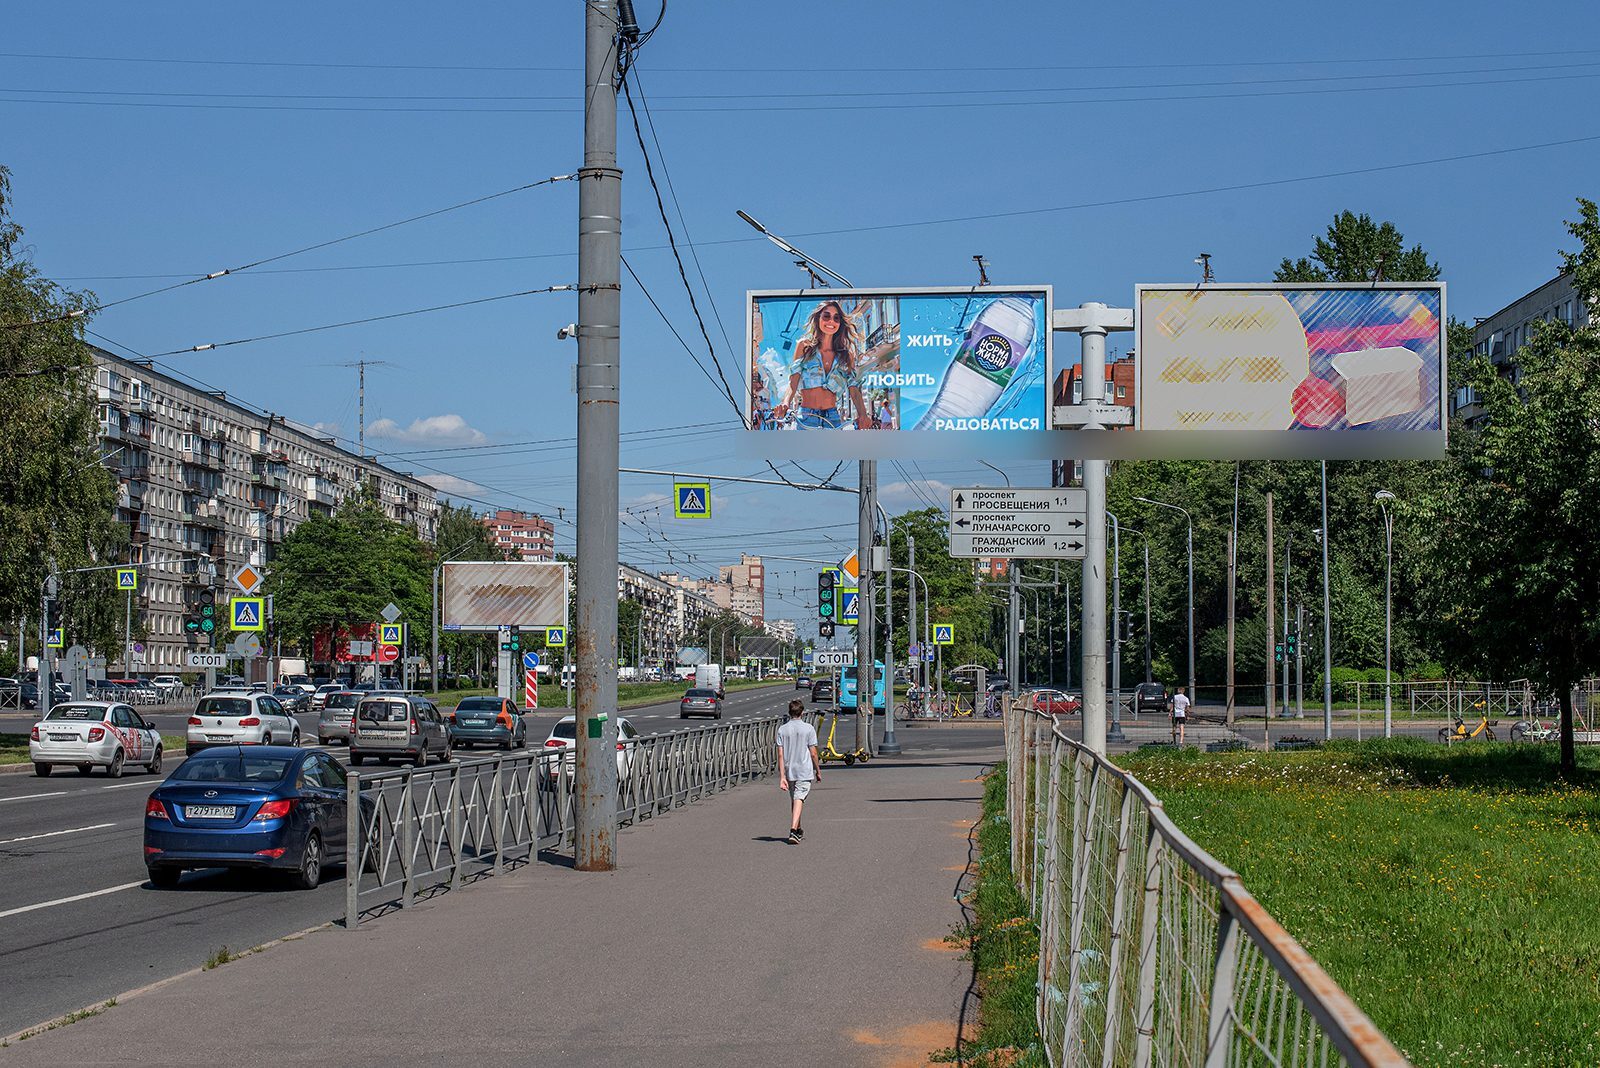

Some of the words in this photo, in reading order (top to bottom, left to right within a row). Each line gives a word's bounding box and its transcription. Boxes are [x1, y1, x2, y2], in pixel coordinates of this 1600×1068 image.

[907, 335, 953, 347] ЖИТЬ
[980, 339, 1009, 361] НОРМА
[976, 347, 1007, 368] ЖИЗНИ
[867, 373, 935, 386] ЛЮБИТЬ
[935, 417, 1040, 431] РАДОВАТЬСЯ
[972, 492, 1016, 500] проспект
[972, 501, 1050, 511] ПРОСВЕЩЕНИЯ
[1054, 497, 1068, 507] 1,1
[972, 523, 1051, 532] ЛУНАЧАРСКОГО
[972, 536, 1046, 547] ГРАЖДАНСКИЙ
[1053, 542, 1067, 551] 1,2
[972, 546, 1016, 554] проспект
[821, 590, 832, 599] 60
[203, 606, 213, 616] 60
[192, 655, 221, 666] СТОП
[818, 653, 849, 664] СТОП
